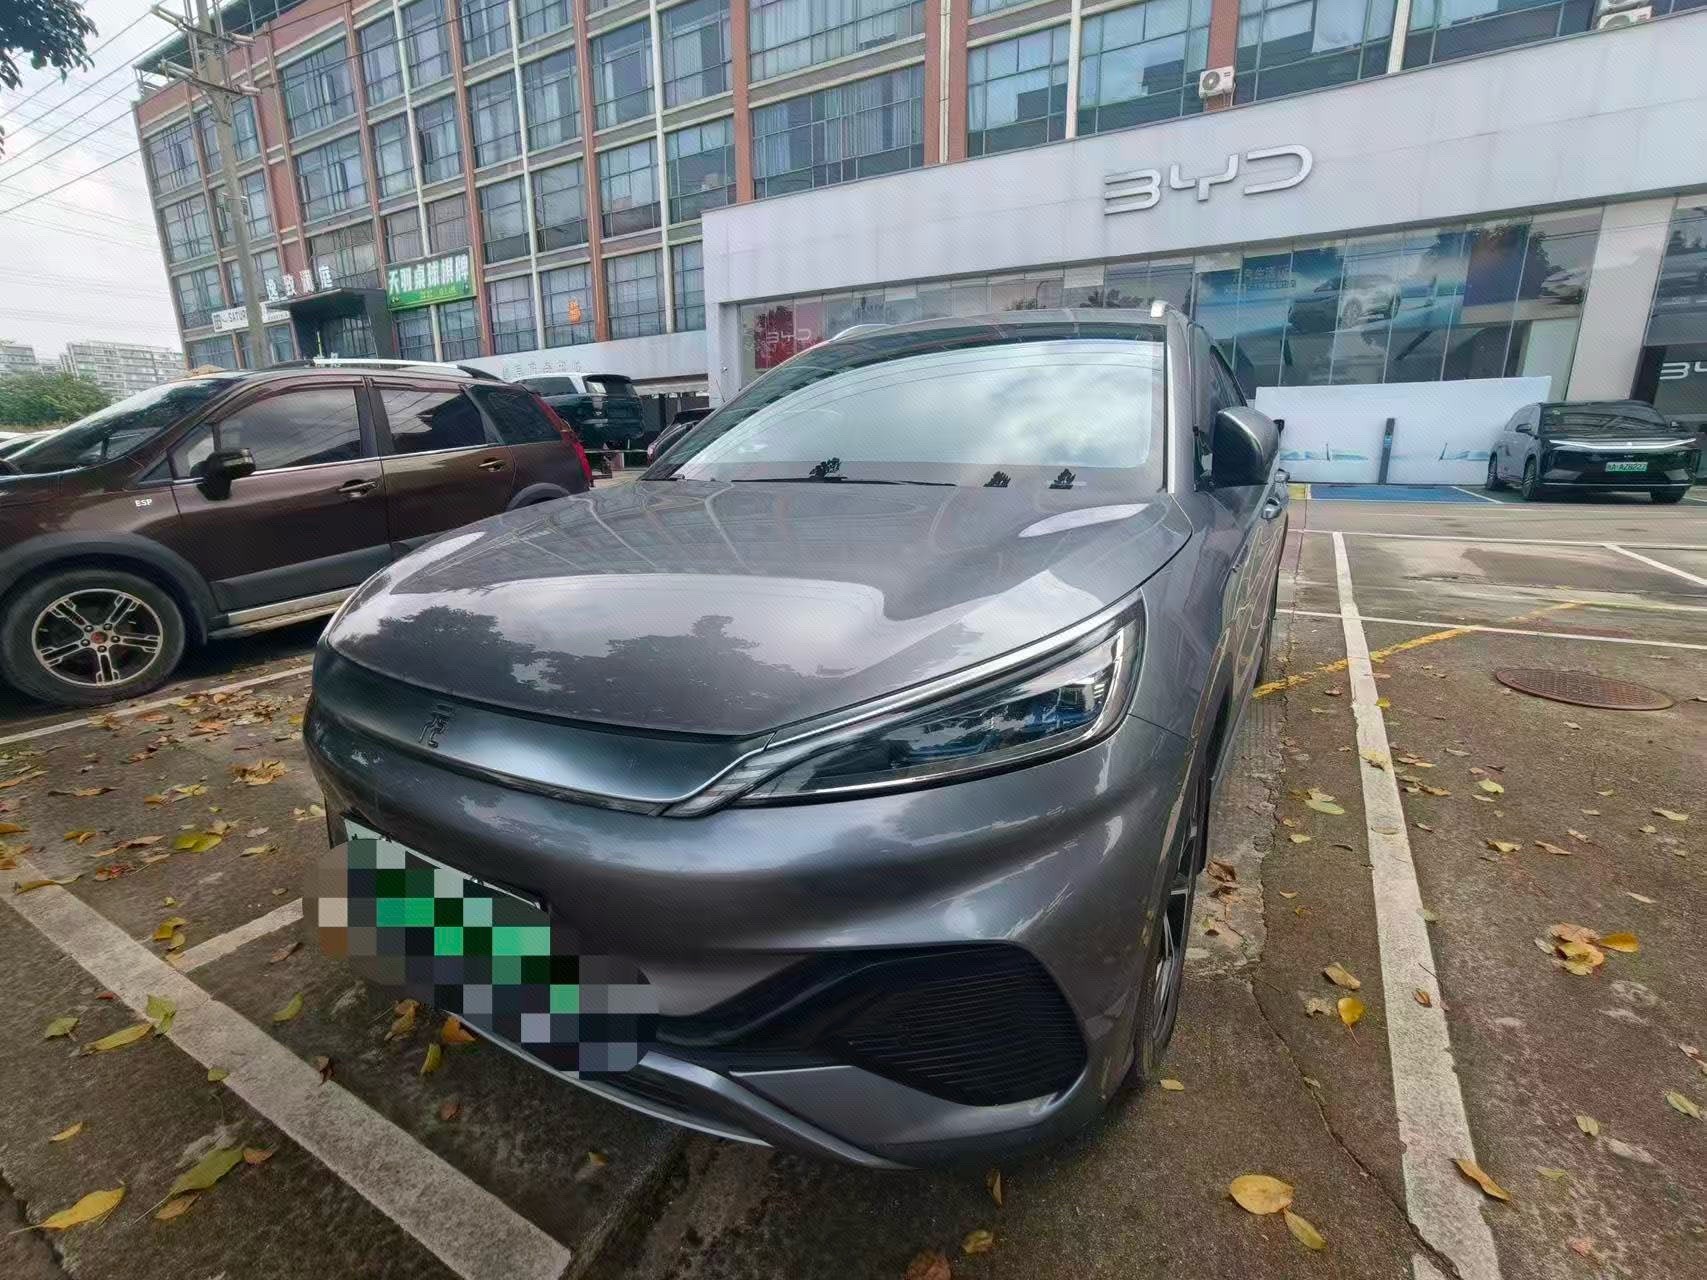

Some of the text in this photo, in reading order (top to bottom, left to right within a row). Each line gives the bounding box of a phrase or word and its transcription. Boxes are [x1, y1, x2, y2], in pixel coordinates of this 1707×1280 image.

[1104, 144, 1314, 216] BYD
[766, 328, 812, 344] BYD
[134, 498, 153, 507] ESP
